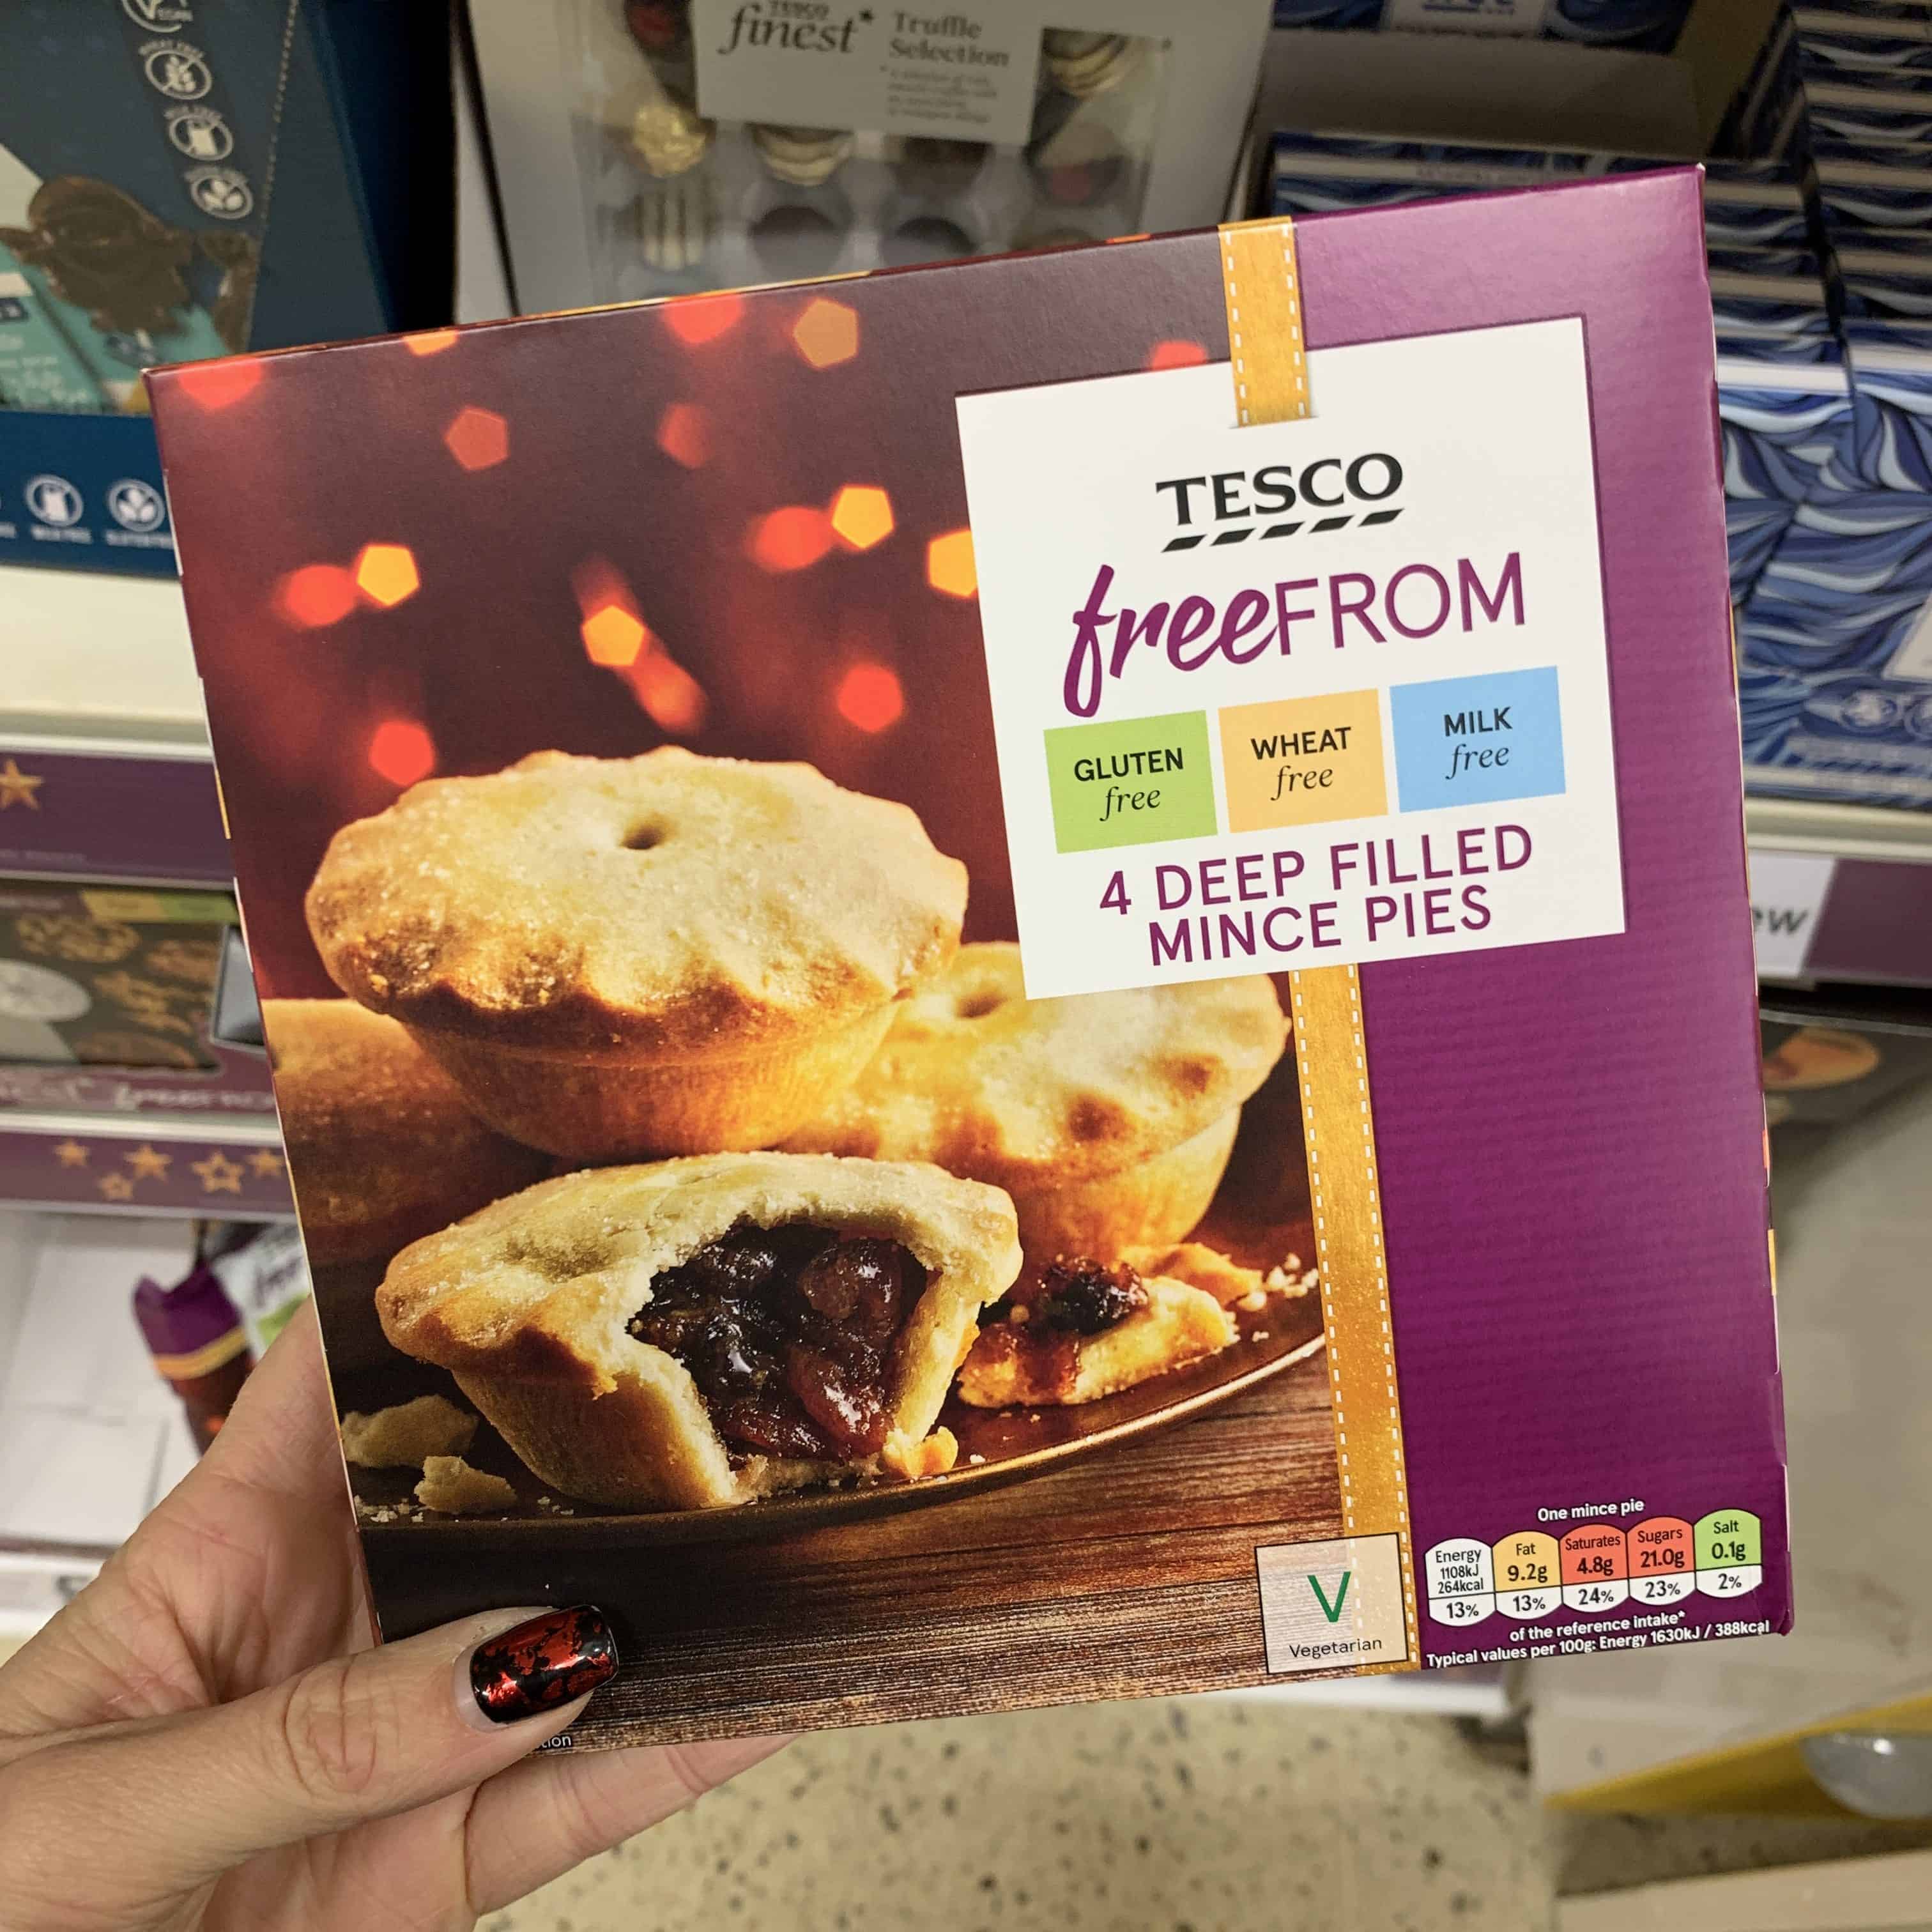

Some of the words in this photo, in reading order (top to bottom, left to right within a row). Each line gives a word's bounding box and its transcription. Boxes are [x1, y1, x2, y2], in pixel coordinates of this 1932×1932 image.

[892, 10, 983, 39] Truffle
[889, 37, 1009, 66] Selection
[1156, 452, 1403, 526] TESCO
[1443, 707, 1513, 737] MILK
[1251, 726, 1352, 760] WHEAT
[1073, 747, 1184, 782] GLUTEN
[1445, 744, 1510, 779] free
[1271, 763, 1333, 801] free
[1100, 784, 1161, 821] free
[1100, 870, 1131, 916] 4
[1155, 850, 1305, 911] DEEP
[1329, 824, 1533, 891] FILLED
[1150, 901, 1342, 967] MINCE
[1366, 884, 1492, 942] PIES
[1537, 1507, 1568, 1521] One
[1571, 1502, 1617, 1519] mince
[1621, 1498, 1644, 1517] pie
[1637, 1528, 1683, 1544] Sugars
[1713, 1520, 1739, 1534] Salt
[1515, 1543, 1536, 1556] Fat
[1565, 1535, 1621, 1551] Saturates
[1712, 1541, 1745, 1561] 0.1g
[1436, 1549, 1482, 1563] Energy
[1577, 1556, 1613, 1576] 4.8g
[1640, 1549, 1685, 1568] 21.0g
[1440, 1564, 1478, 1579] 1108kJ
[1507, 1563, 1548, 1583] 9.2g
[1717, 1573, 1742, 1590] 2%
[1438, 1578, 1483, 1594] 264kcal
[1645, 1581, 1681, 1598] 23%
[1307, 1571, 1351, 1623] V
[1513, 1595, 1546, 1613] 13%
[1578, 1588, 1614, 1606] 24%
[1446, 1602, 1479, 1619] 13%
[1509, 1627, 1527, 1641] of
[1528, 1626, 1552, 1639] the
[1556, 1620, 1629, 1637] reference
[1289, 1638, 1382, 1659] Vegetarian
[1426, 1650, 1477, 1668] Typical
[1481, 1646, 1527, 1661] values
[1531, 1643, 1555, 1658] per
[1559, 1638, 1597, 1653] 100g:
[1599, 1633, 1646, 1648] Energy
[1650, 1626, 1699, 1644] 1630kJ
[1703, 1623, 1712, 1639] /
[1715, 1620, 1770, 1636] 388kcal
